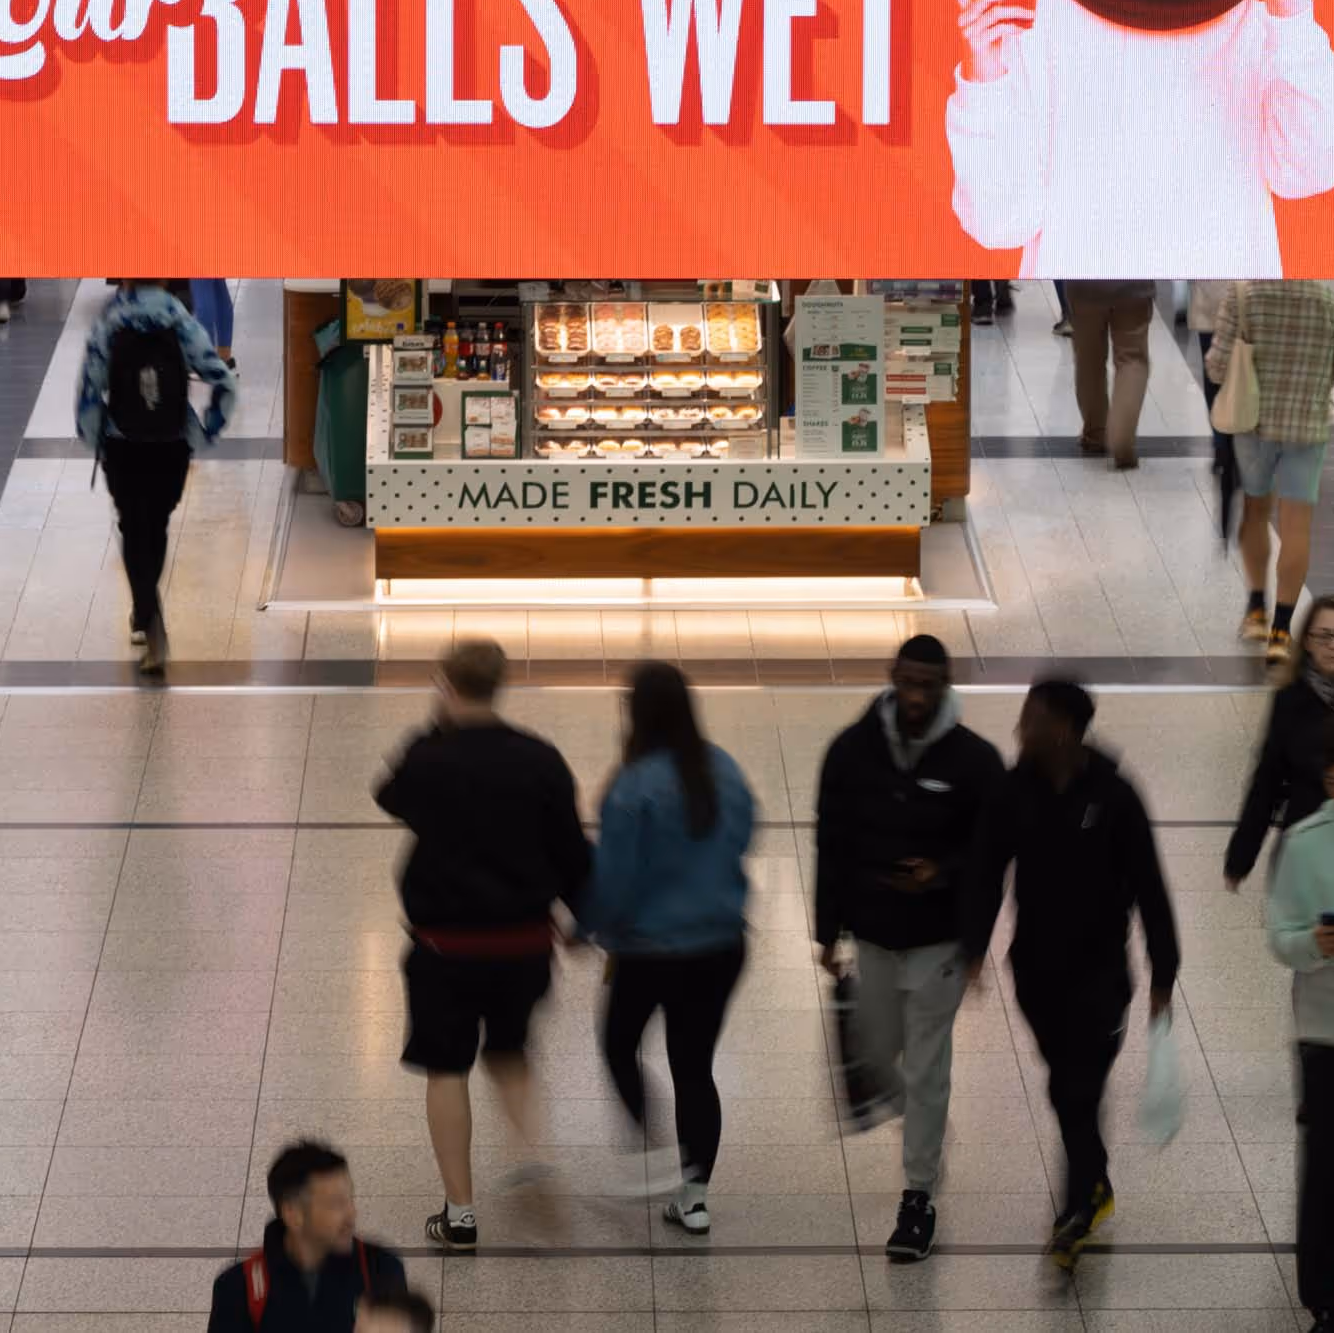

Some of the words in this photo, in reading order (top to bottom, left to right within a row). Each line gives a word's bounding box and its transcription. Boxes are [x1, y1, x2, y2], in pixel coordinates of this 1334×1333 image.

[458, 481, 569, 509] MADE
[589, 481, 712, 509] FRESH
[733, 481, 839, 509] DAILY
